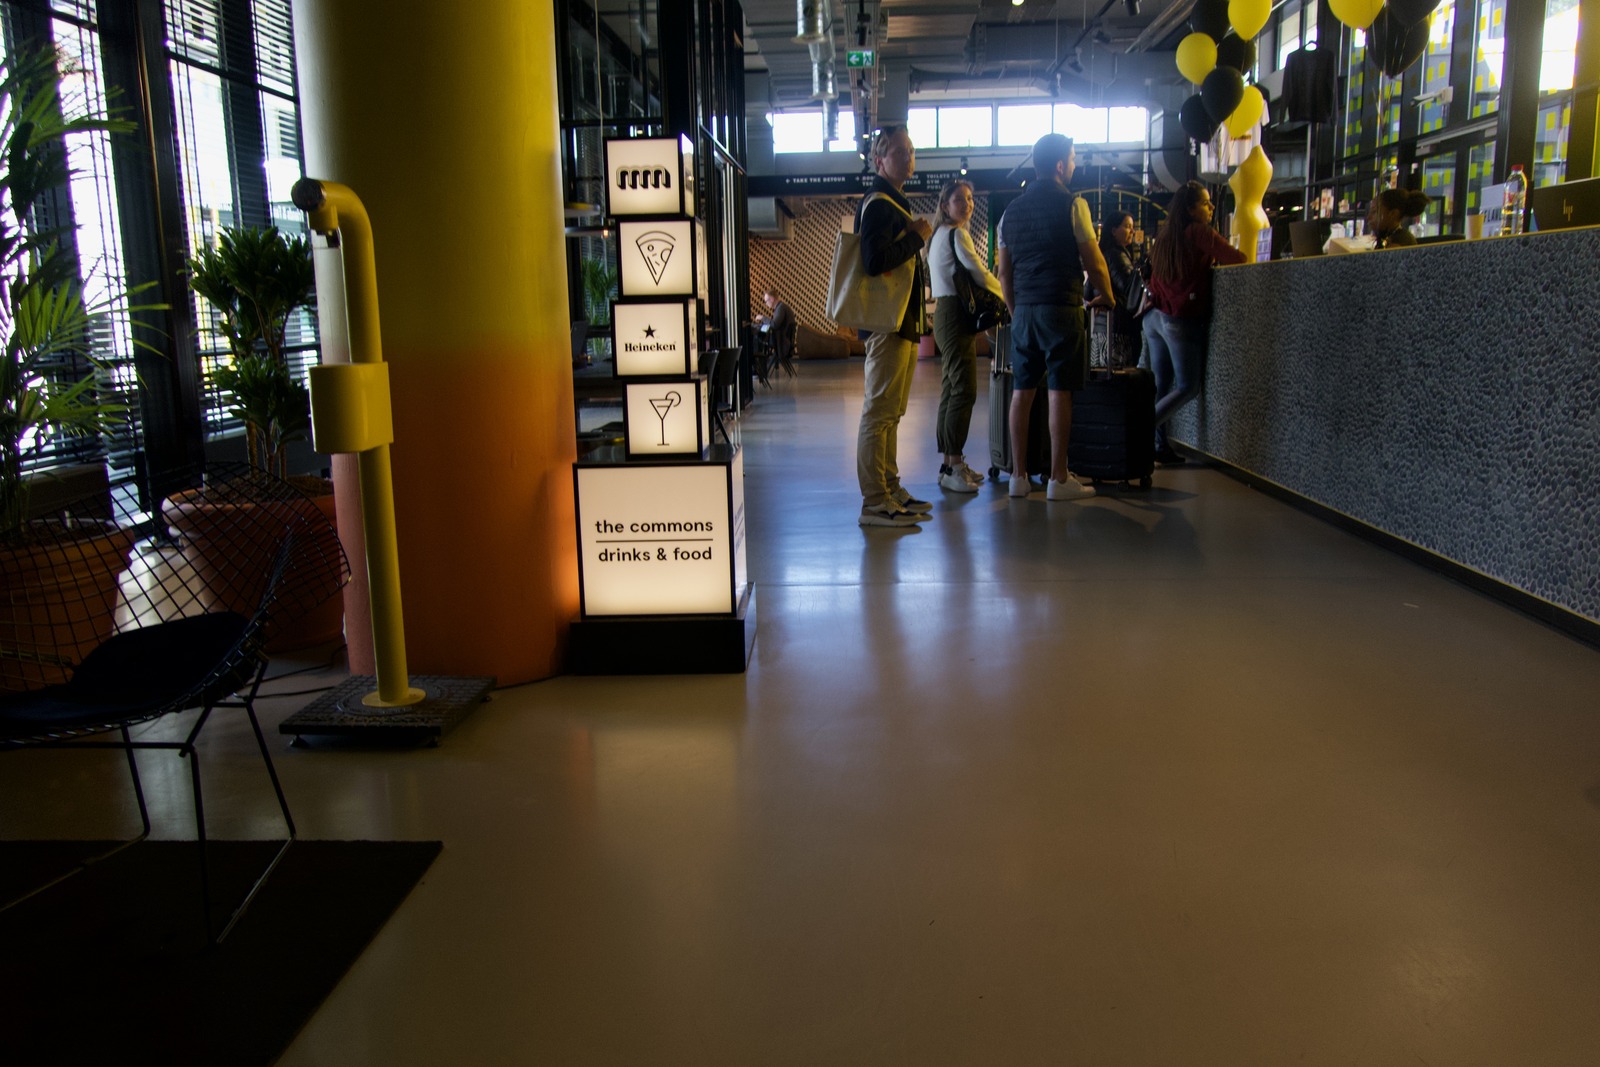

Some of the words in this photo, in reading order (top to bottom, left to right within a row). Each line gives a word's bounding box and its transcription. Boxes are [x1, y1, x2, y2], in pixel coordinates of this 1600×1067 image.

[624, 342, 676, 352] Heineken
[595, 520, 625, 534] the
[630, 520, 714, 533] commons
[598, 547, 651, 562] drinks
[656, 547, 667, 561] &
[673, 546, 712, 561] food
